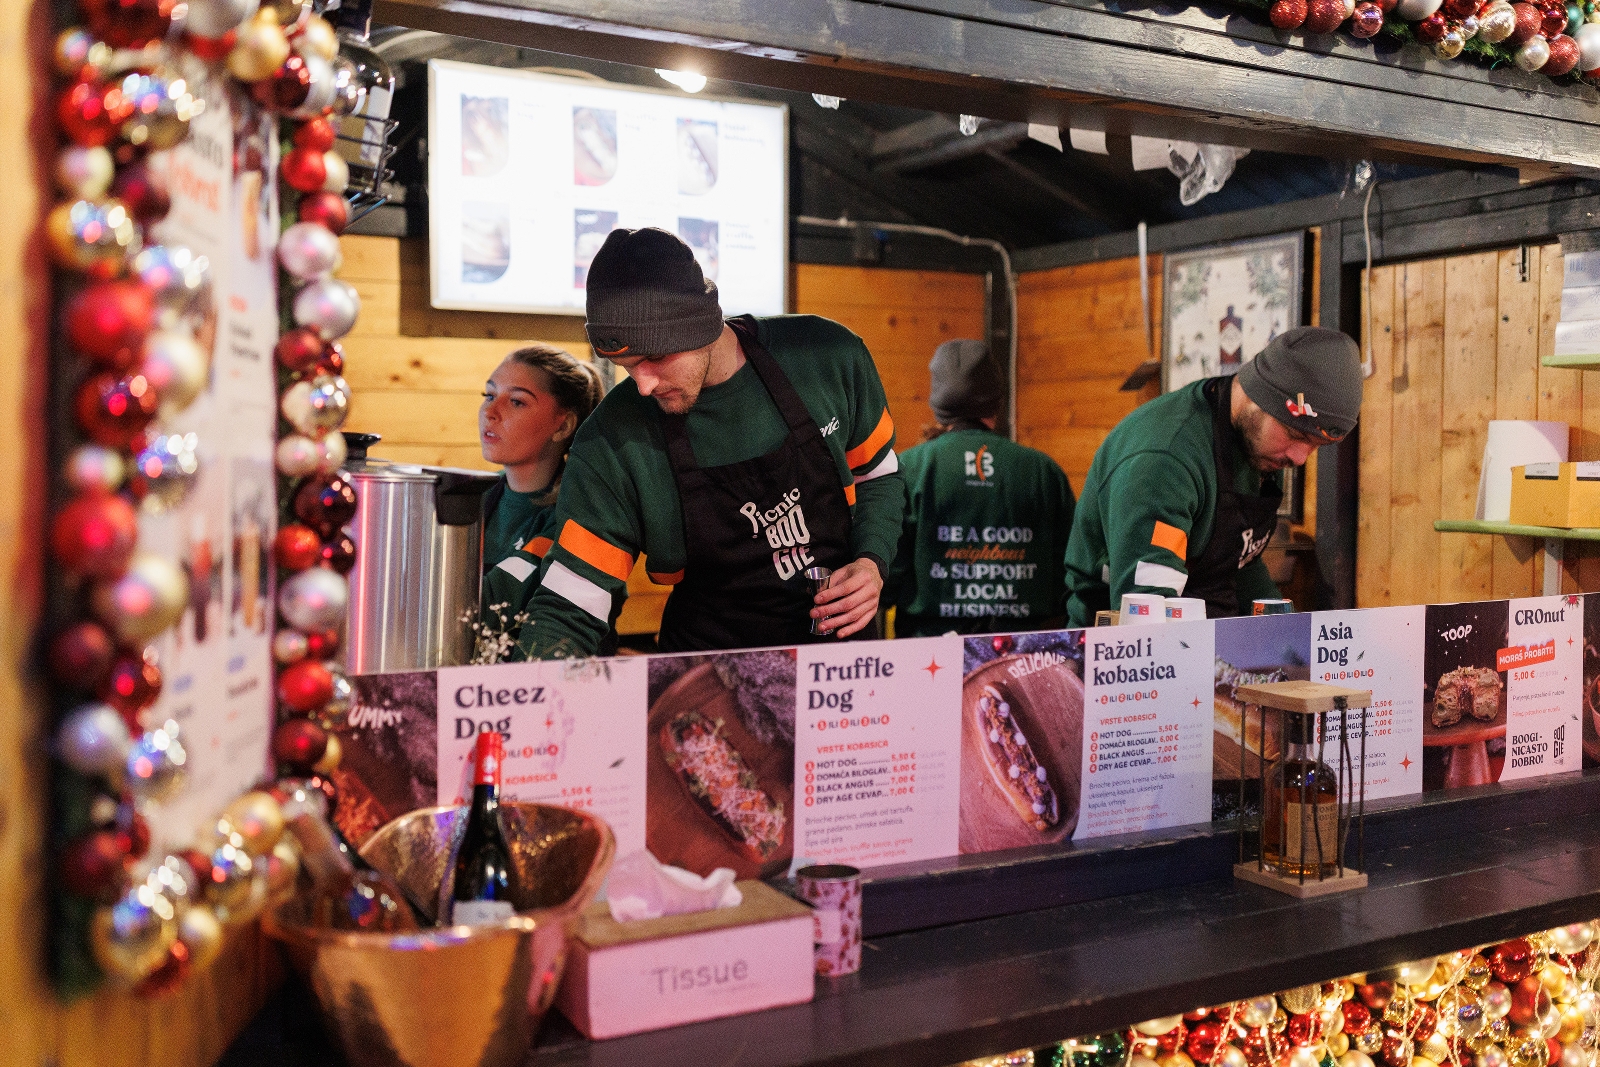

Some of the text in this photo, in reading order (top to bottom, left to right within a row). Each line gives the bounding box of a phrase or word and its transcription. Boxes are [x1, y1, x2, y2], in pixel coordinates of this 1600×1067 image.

[820, 417, 840, 438] nic
[740, 488, 800, 539] Picnic
[766, 504, 811, 549] BOO
[937, 526, 1033, 543] BE A GOOD
[773, 547, 815, 580] GIE
[930, 562, 1037, 580] & SUPPORT
[954, 583, 1018, 600] LOCAL
[940, 603, 1030, 618] BUSINESS
[1514, 607, 1565, 626] CROnut
[1317, 622, 1353, 641] Asia
[1441, 624, 1472, 642] TOOP
[1093, 638, 1152, 661] Fažol i
[1317, 647, 1348, 666] Dog
[808, 656, 894, 682] Truffle
[1008, 651, 1067, 679] DELICIOUS
[1093, 662, 1176, 686] kobasica
[1514, 672, 1528, 681] 5,00
[454, 683, 548, 708] Cheez
[808, 690, 854, 712] Dog
[348, 703, 401, 729] UMMY
[1100, 712, 1157, 726] VRSTE KOBASICA
[454, 716, 511, 742] Dog
[1116, 730, 1132, 738] DOG
[1158, 725, 1173, 733] 5,50
[817, 740, 888, 754] VRSTE KOBASICA
[1160, 735, 1173, 743] 6,00
[1512, 732, 1538, 745] BOOGI
[1099, 752, 1120, 761] BLACK
[1122, 749, 1145, 757] ANGUS
[1158, 745, 1172, 753] 7,00
[1512, 743, 1548, 756] NICASTO
[816, 761, 834, 769] HOT
[838, 759, 857, 768] DOG
[1098, 763, 1112, 772] DRY
[1114, 761, 1128, 769] AGE
[1512, 754, 1544, 768] DOBRO!
[816, 783, 842, 793] BLACK
[845, 780, 874, 789] ANGUS
[816, 796, 834, 805] DRY
[836, 794, 853, 802] AGE
[652, 958, 749, 994] Tissue
